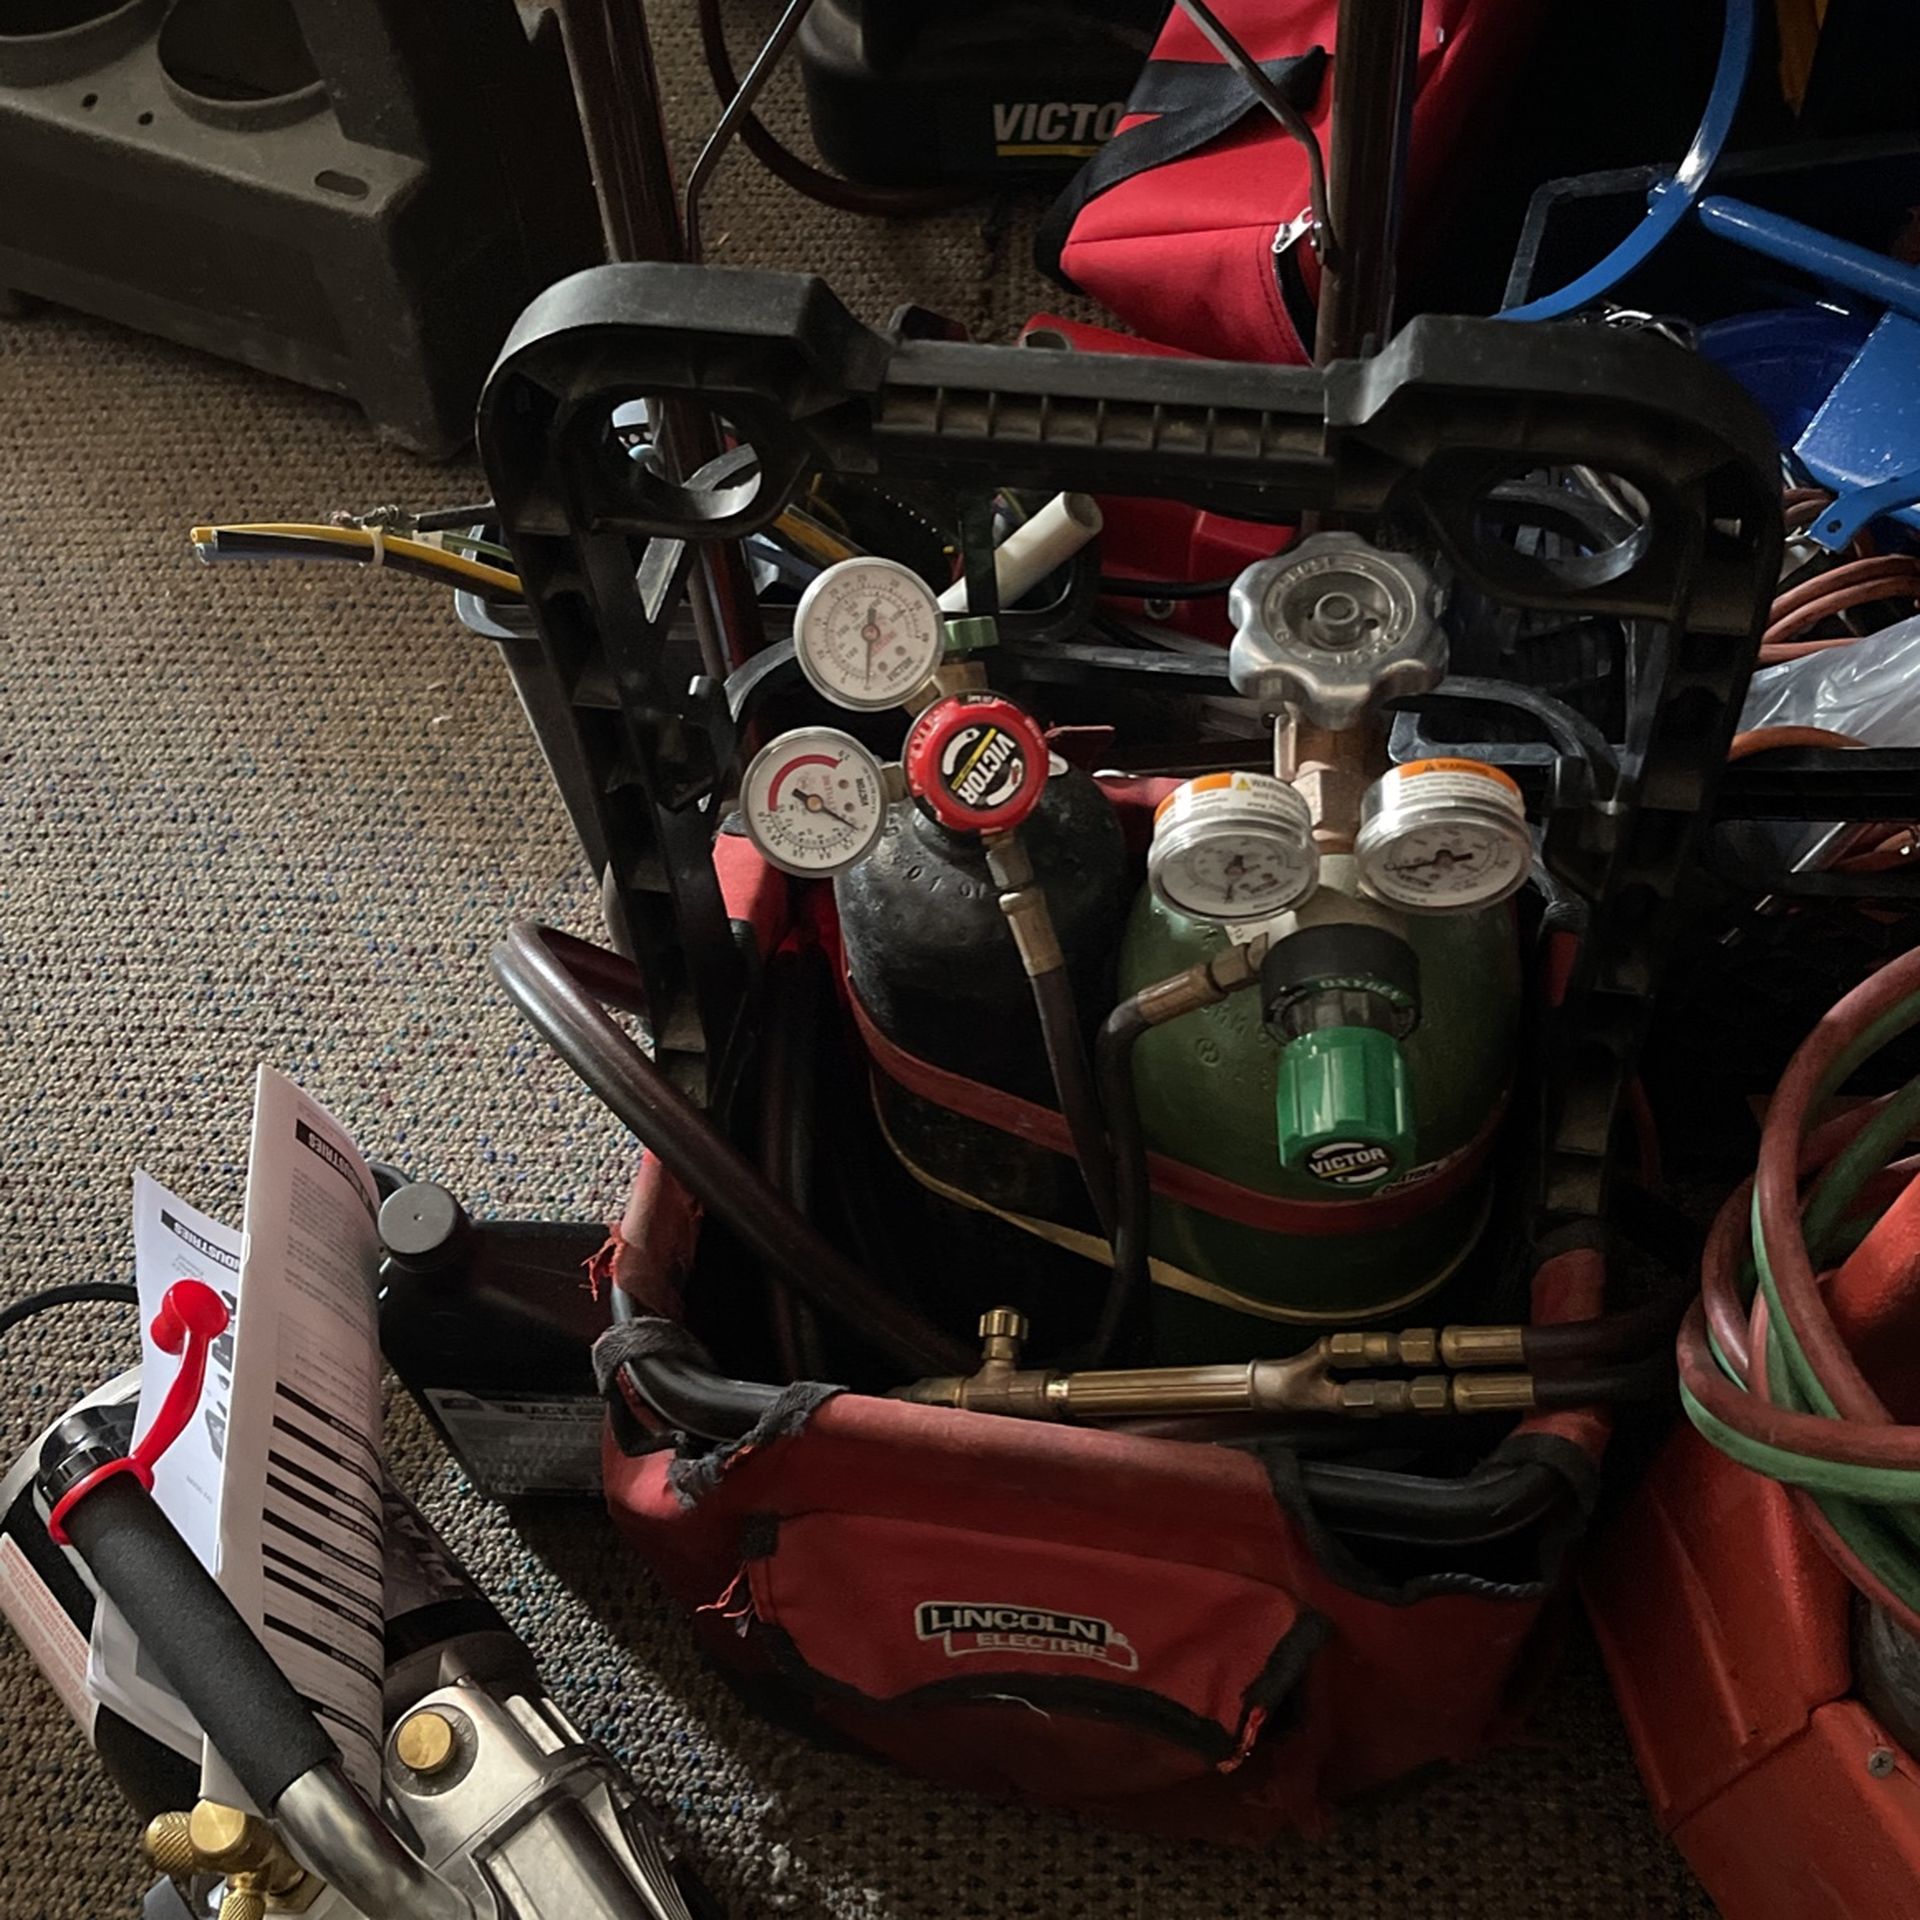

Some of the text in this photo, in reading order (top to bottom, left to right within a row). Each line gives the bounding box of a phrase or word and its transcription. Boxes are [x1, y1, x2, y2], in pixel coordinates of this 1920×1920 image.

[993, 102, 1127, 142] VICTO
[957, 733, 1016, 805] VICTOR
[855, 778, 870, 808] VICTOR
[1319, 979, 1401, 1000] OXYGEN
[1308, 1147, 1387, 1175] VICTOR
[931, 1607, 1098, 1641] LINCOLN
[977, 1633, 1108, 1657] ELECTRIC
